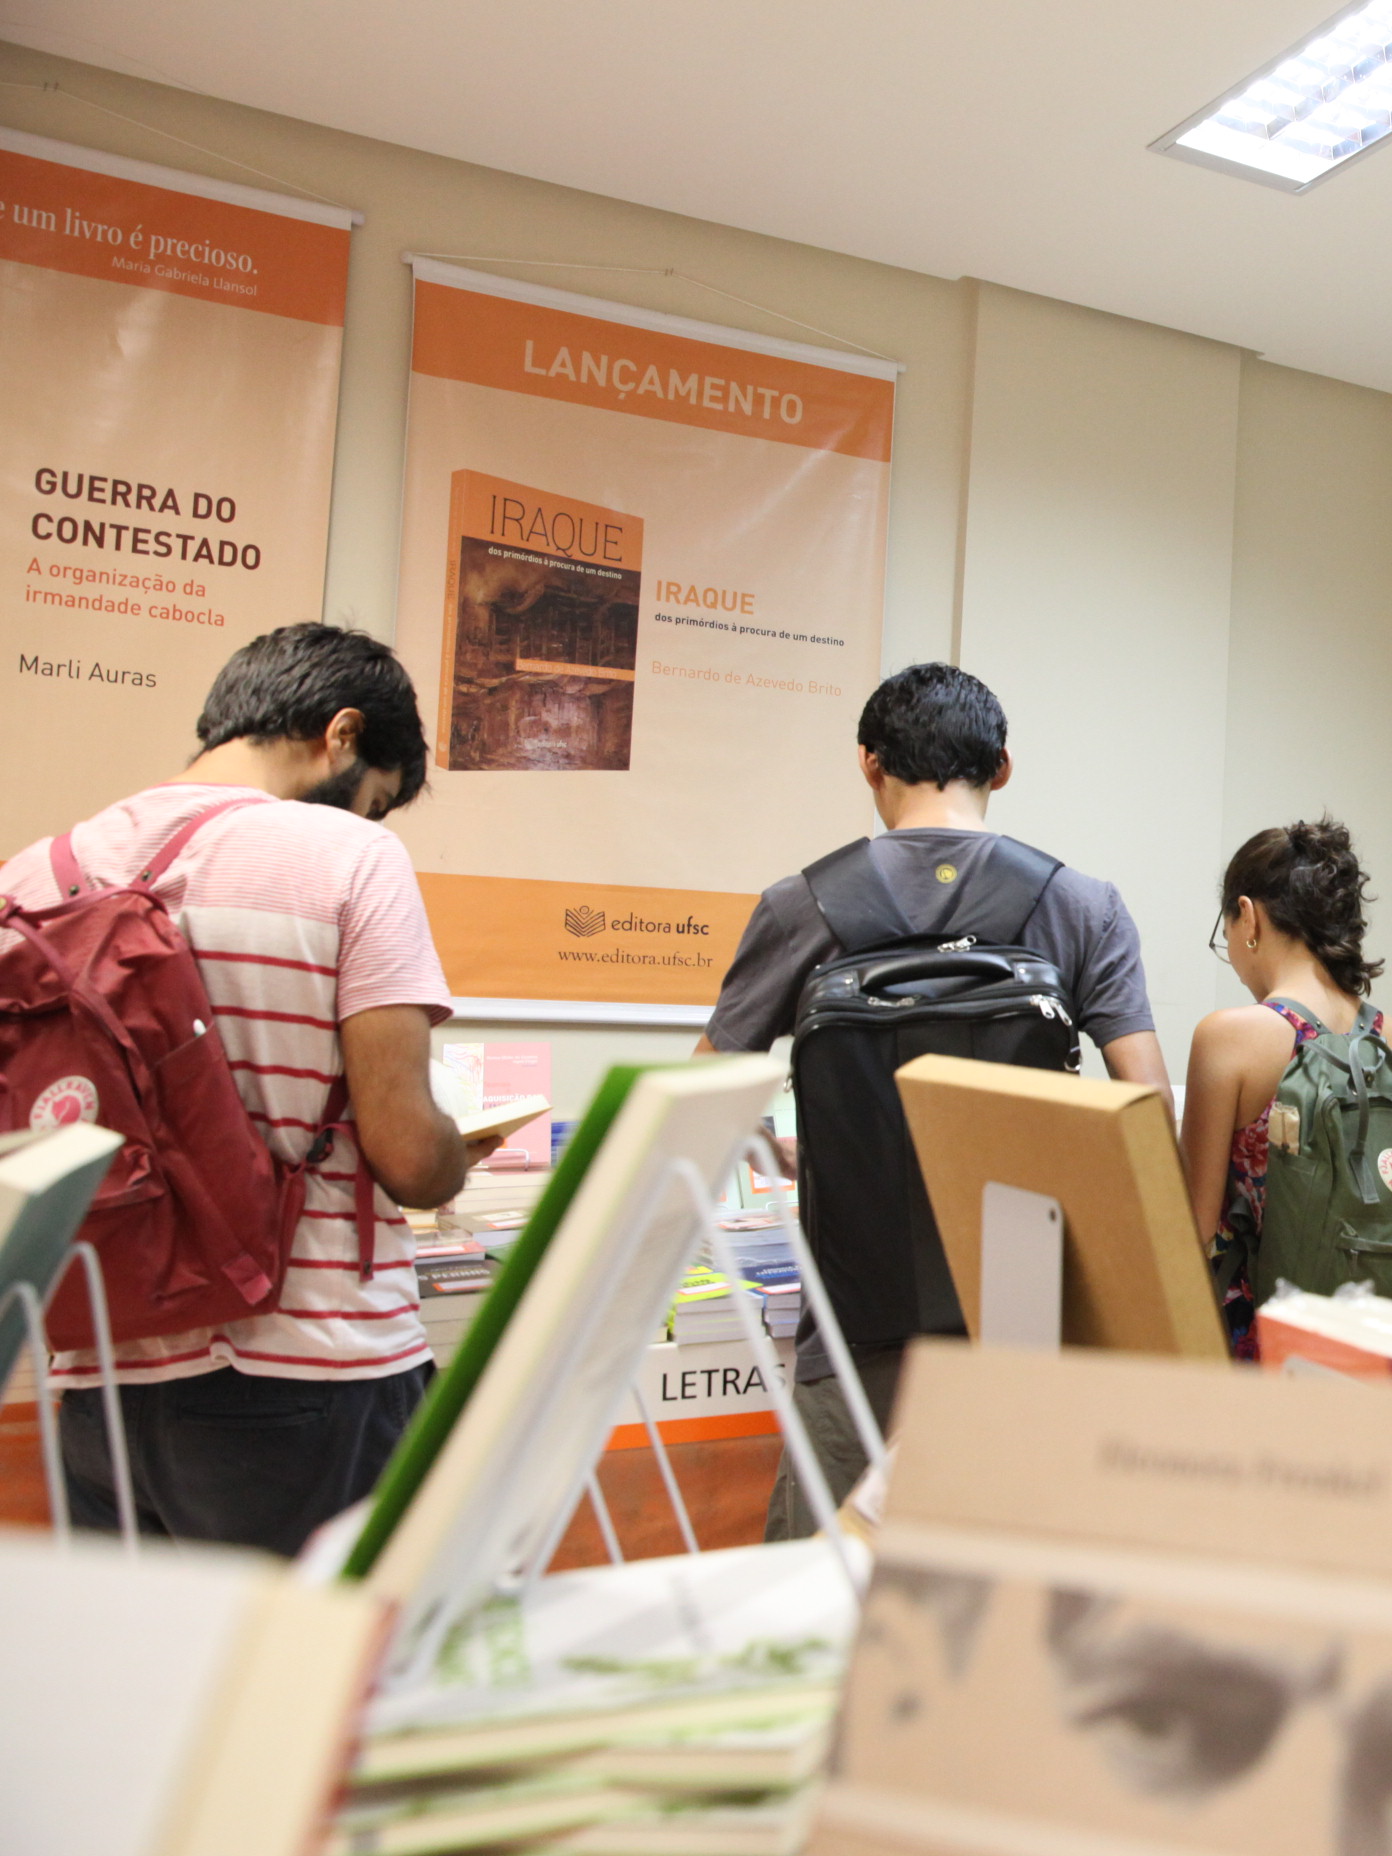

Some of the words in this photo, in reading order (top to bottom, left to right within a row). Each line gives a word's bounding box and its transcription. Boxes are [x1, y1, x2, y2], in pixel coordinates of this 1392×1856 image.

[13, 203, 57, 232] um
[64, 207, 123, 246] livro
[129, 224, 143, 249] é
[149, 233, 259, 275] precioso.
[112, 255, 151, 274] Maria
[154, 264, 210, 287] Gabriela
[213, 277, 257, 296] Llansol
[523, 339, 804, 425] LANÇAMENTO
[34, 467, 181, 516] GUERRA
[192, 491, 237, 524] DO
[31, 512, 261, 570] CONTESTADO
[490, 494, 624, 563] IRAQUE
[26, 557, 42, 575] A
[49, 562, 176, 594] organização
[183, 579, 206, 597] da
[488, 546, 502, 557] dos
[503, 548, 542, 566] primórdios
[549, 557, 575, 572] procura
[576, 564, 585, 574] de
[585, 567, 596, 576] um
[598, 568, 622, 580] destino
[25, 585, 142, 616] irmandade
[149, 604, 225, 627] cabocla
[655, 579, 755, 615] IRAQUE
[655, 612, 672, 623] dos
[675, 615, 729, 631] primórdios
[739, 624, 776, 638] procura
[779, 630, 790, 640] de
[793, 633, 807, 642] um
[810, 634, 844, 647] destino
[19, 653, 81, 680] Marli
[88, 662, 157, 688] Auras
[652, 660, 720, 682] Bernardo
[724, 670, 742, 685] de
[746, 673, 803, 692] Azevedo
[808, 681, 842, 697] Brito
[611, 912, 671, 934] editora
[676, 915, 709, 936] ufsc
[558, 948, 714, 968] www.editora.ufsc.br
